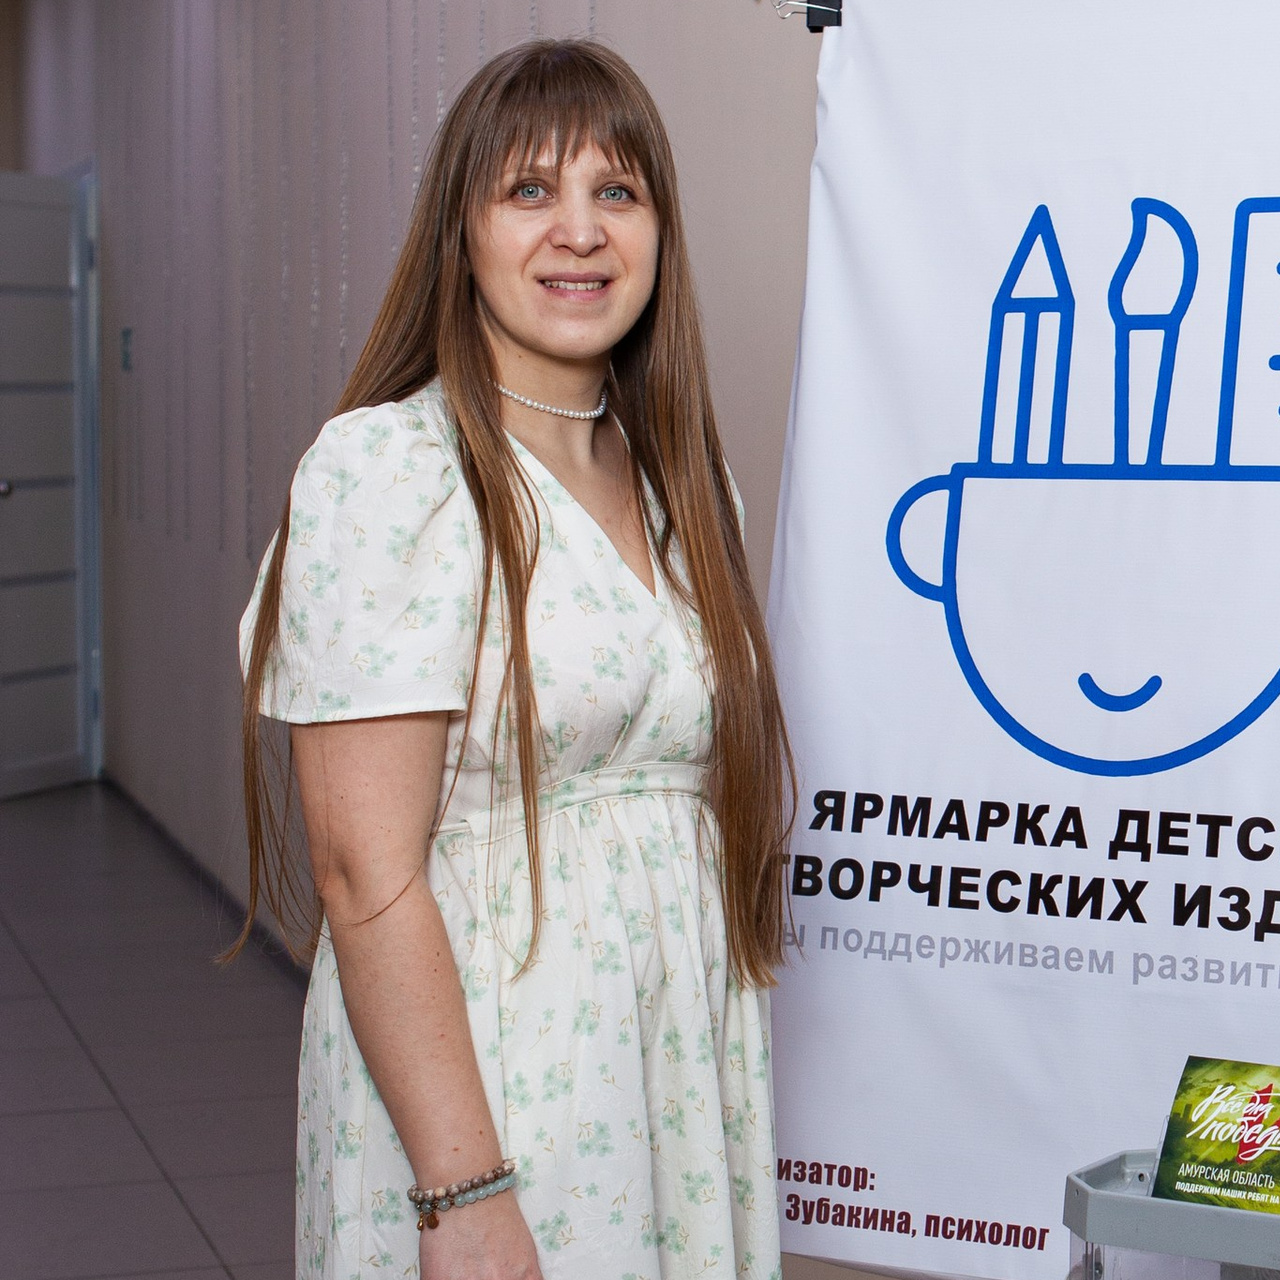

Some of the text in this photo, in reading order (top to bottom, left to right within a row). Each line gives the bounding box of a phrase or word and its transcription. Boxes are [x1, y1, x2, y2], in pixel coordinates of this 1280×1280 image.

[808, 789, 1089, 850] ЯРМАРКА
[783, 923, 805, 947] ы
[819, 926, 1115, 977] поддерживаем
[777, 1158, 876, 1192] изатор:
[1175, 1181, 1220, 1196] ПОДДЕРЖИМ
[1221, 1188, 1247, 1200] НАШИХ
[1247, 1192, 1269, 1203] РЕБЯТ
[1270, 1195, 1280, 1204] НА
[1178, 1163, 1276, 1189] АМУРСКАЯ ОБЛАСТЬ
[785, 1193, 1050, 1251] Зубакина, психолог
